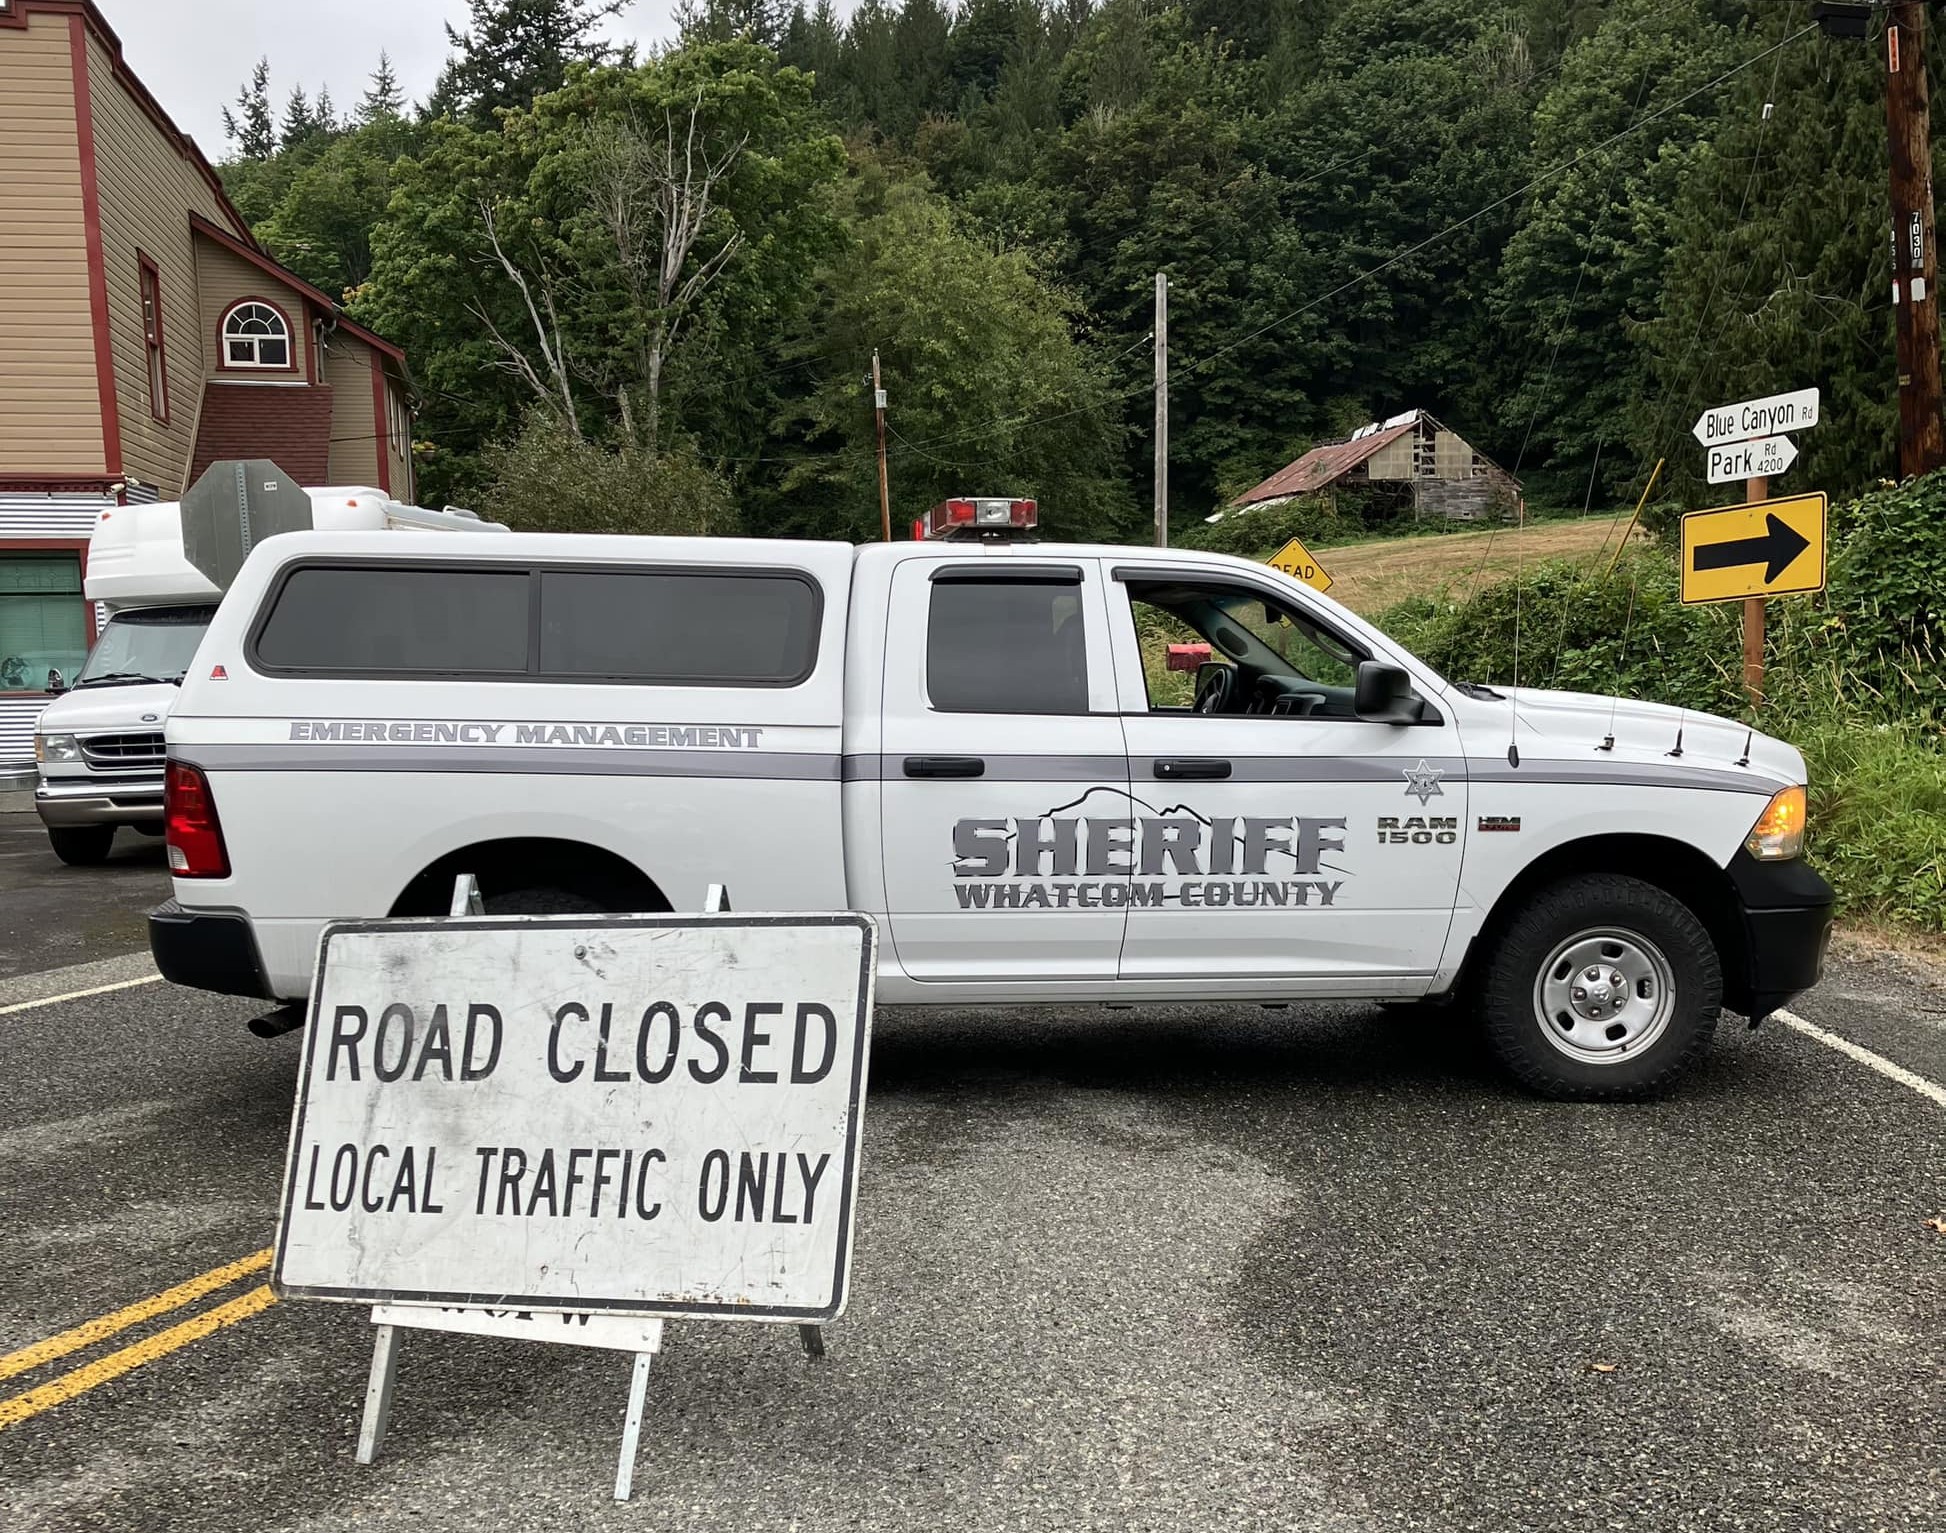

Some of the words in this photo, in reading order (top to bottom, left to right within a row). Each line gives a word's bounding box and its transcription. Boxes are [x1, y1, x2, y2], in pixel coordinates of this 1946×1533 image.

[1912, 212, 1921, 258] 7030
[1706, 413, 1734, 439] Blue
[1741, 403, 1794, 436] Canyon
[1801, 406, 1813, 420] Rd
[1711, 448, 1752, 477] Park
[1764, 443, 1777, 456] Rd
[1757, 457, 1783, 473] 4200
[289, 722, 505, 743] EMERGENCY
[515, 724, 764, 749] MANAGEMENT
[1376, 816, 1458, 830] RAM
[1376, 831, 1457, 845] 1500
[952, 816, 1347, 877] SHERIFF
[952, 882, 1166, 909] WHATCOM
[1179, 880, 1344, 908] COUNTY
[326, 1003, 504, 1083] ROAD
[548, 1001, 838, 1085] CLOSED
[305, 1142, 444, 1214] LOCAL
[475, 1146, 667, 1221] TRAFFIC
[699, 1148, 831, 1225] ONLY
